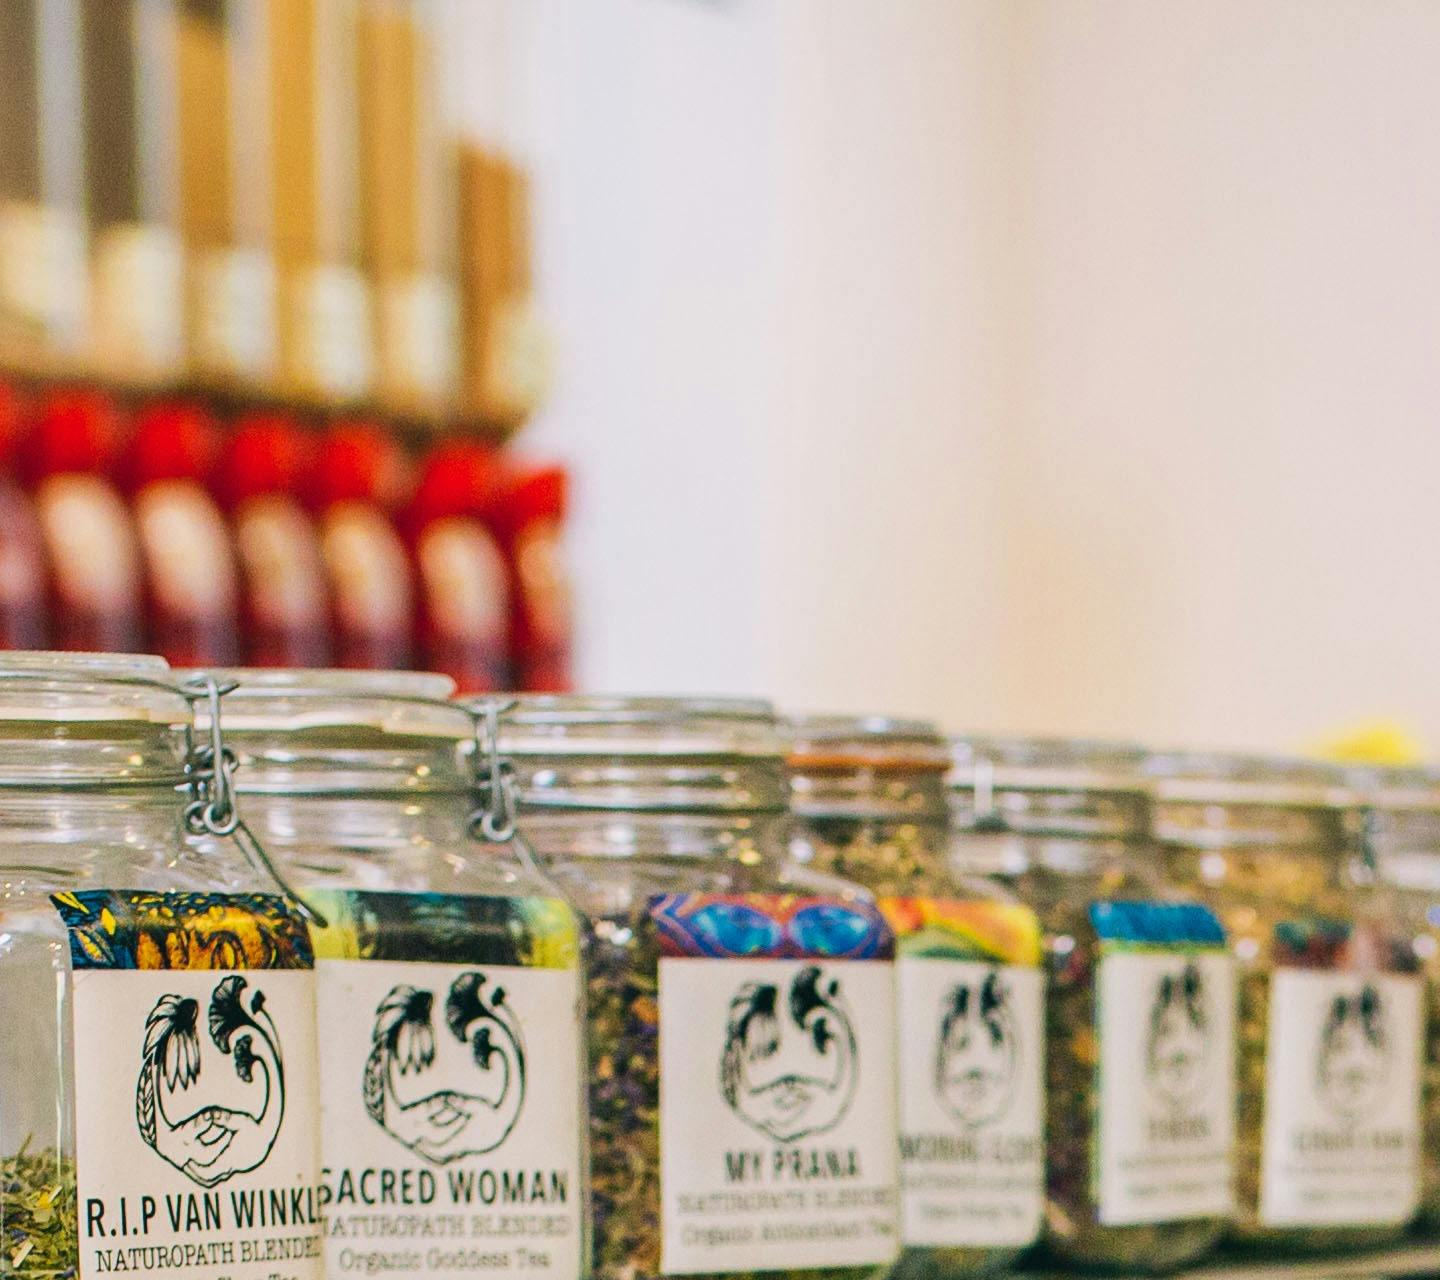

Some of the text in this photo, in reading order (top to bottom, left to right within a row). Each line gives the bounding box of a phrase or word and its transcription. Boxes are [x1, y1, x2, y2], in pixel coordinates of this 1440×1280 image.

[447, 1168, 569, 1205] WOMAN
[86, 1196, 156, 1238] R.I.P
[166, 1191, 221, 1233] VAN
[471, 1213, 572, 1238] BLENDED
[95, 1234, 320, 1273] NATUROPATH BLENDE
[339, 1248, 422, 1275] Organic
[517, 1246, 552, 1269] Tea
